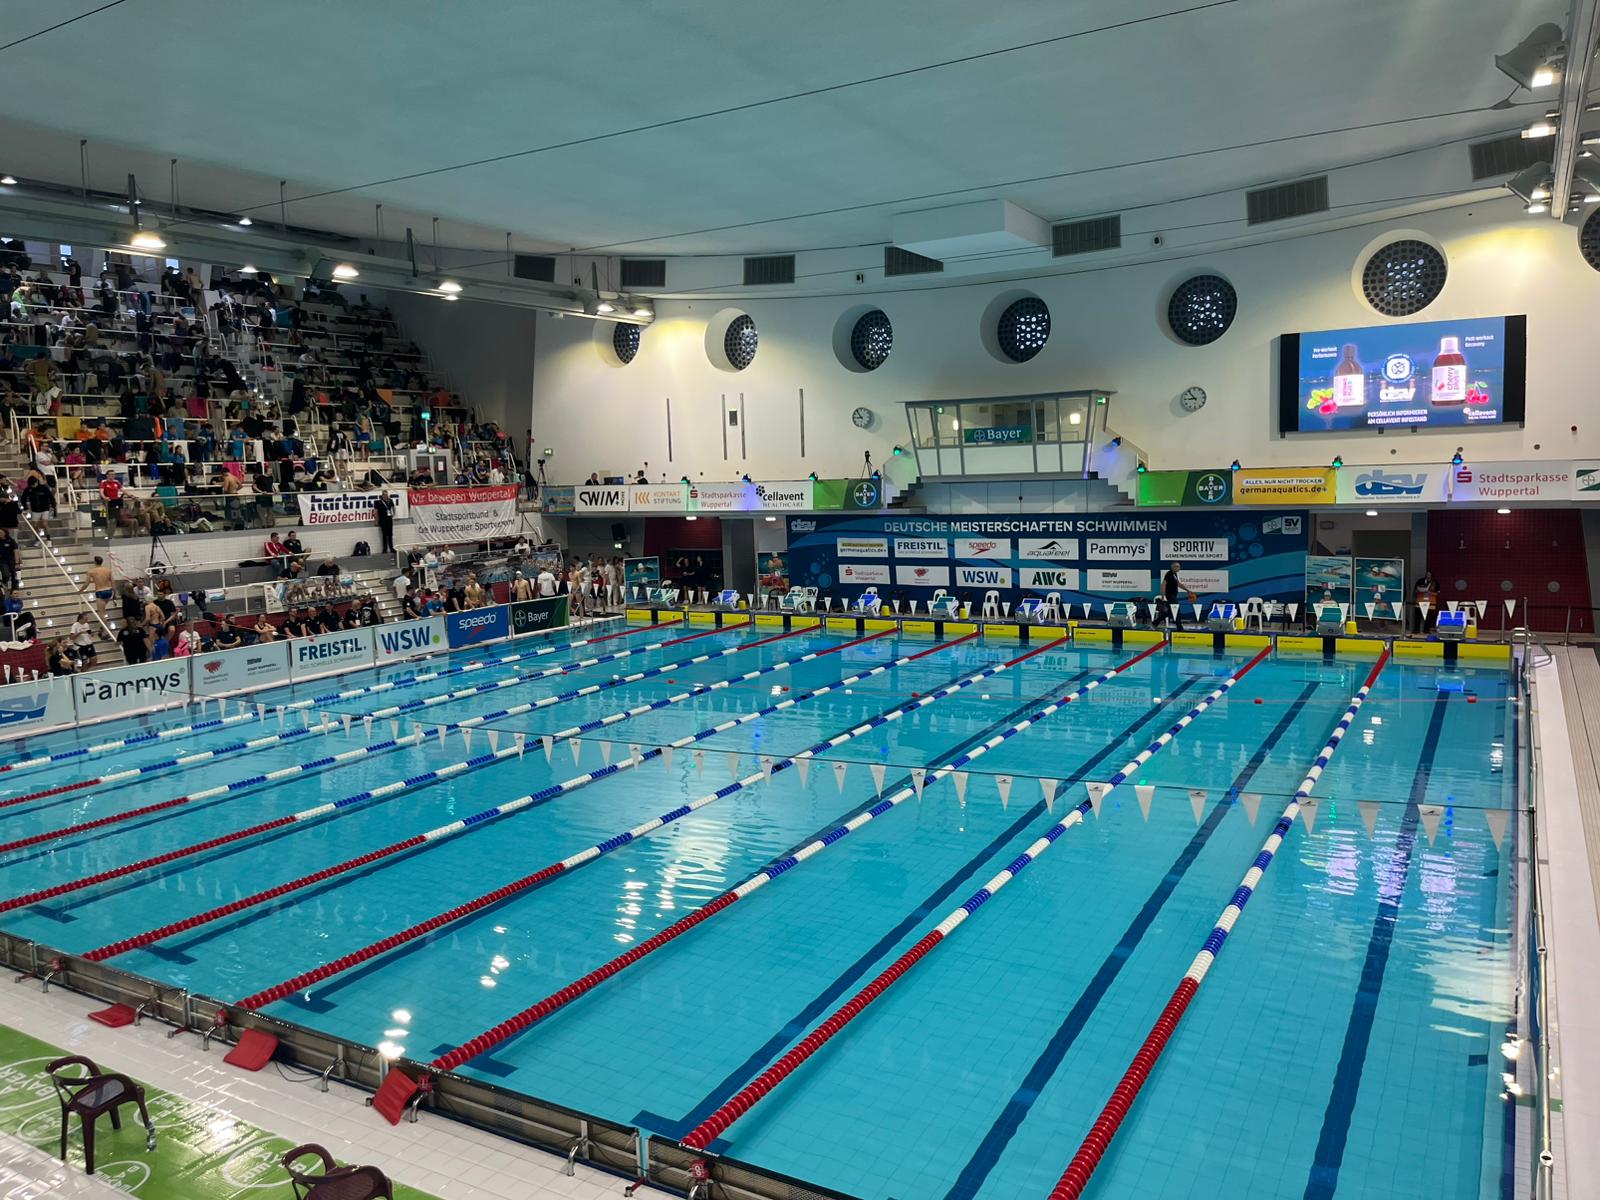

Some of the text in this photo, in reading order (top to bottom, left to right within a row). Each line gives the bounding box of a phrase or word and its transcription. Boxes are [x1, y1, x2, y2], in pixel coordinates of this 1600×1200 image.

[987, 428, 1021, 440] Bayer
[1479, 473, 1568, 484] Stadtsparkasse
[701, 491, 747, 500] Stadtsparkasse
[763, 491, 804, 501] cellavent
[1479, 486, 1540, 497] Wuppertal
[428, 491, 466, 504] bewegen
[884, 520, 1167, 532] DEUTSCHE MEISTERSCHAFTEN SCHWIMMEN
[1284, 518, 1299, 527] SV
[969, 541, 997, 549] speedo
[1090, 543, 1146, 557] Pammys
[1173, 541, 1215, 552] SPORTIV
[1026, 550, 1070, 558] aquafeel
[1032, 571, 1066, 586] AWG
[458, 614, 497, 630] speedo
[527, 611, 549, 623] Bayer
[82, 672, 181, 703] Pammys
